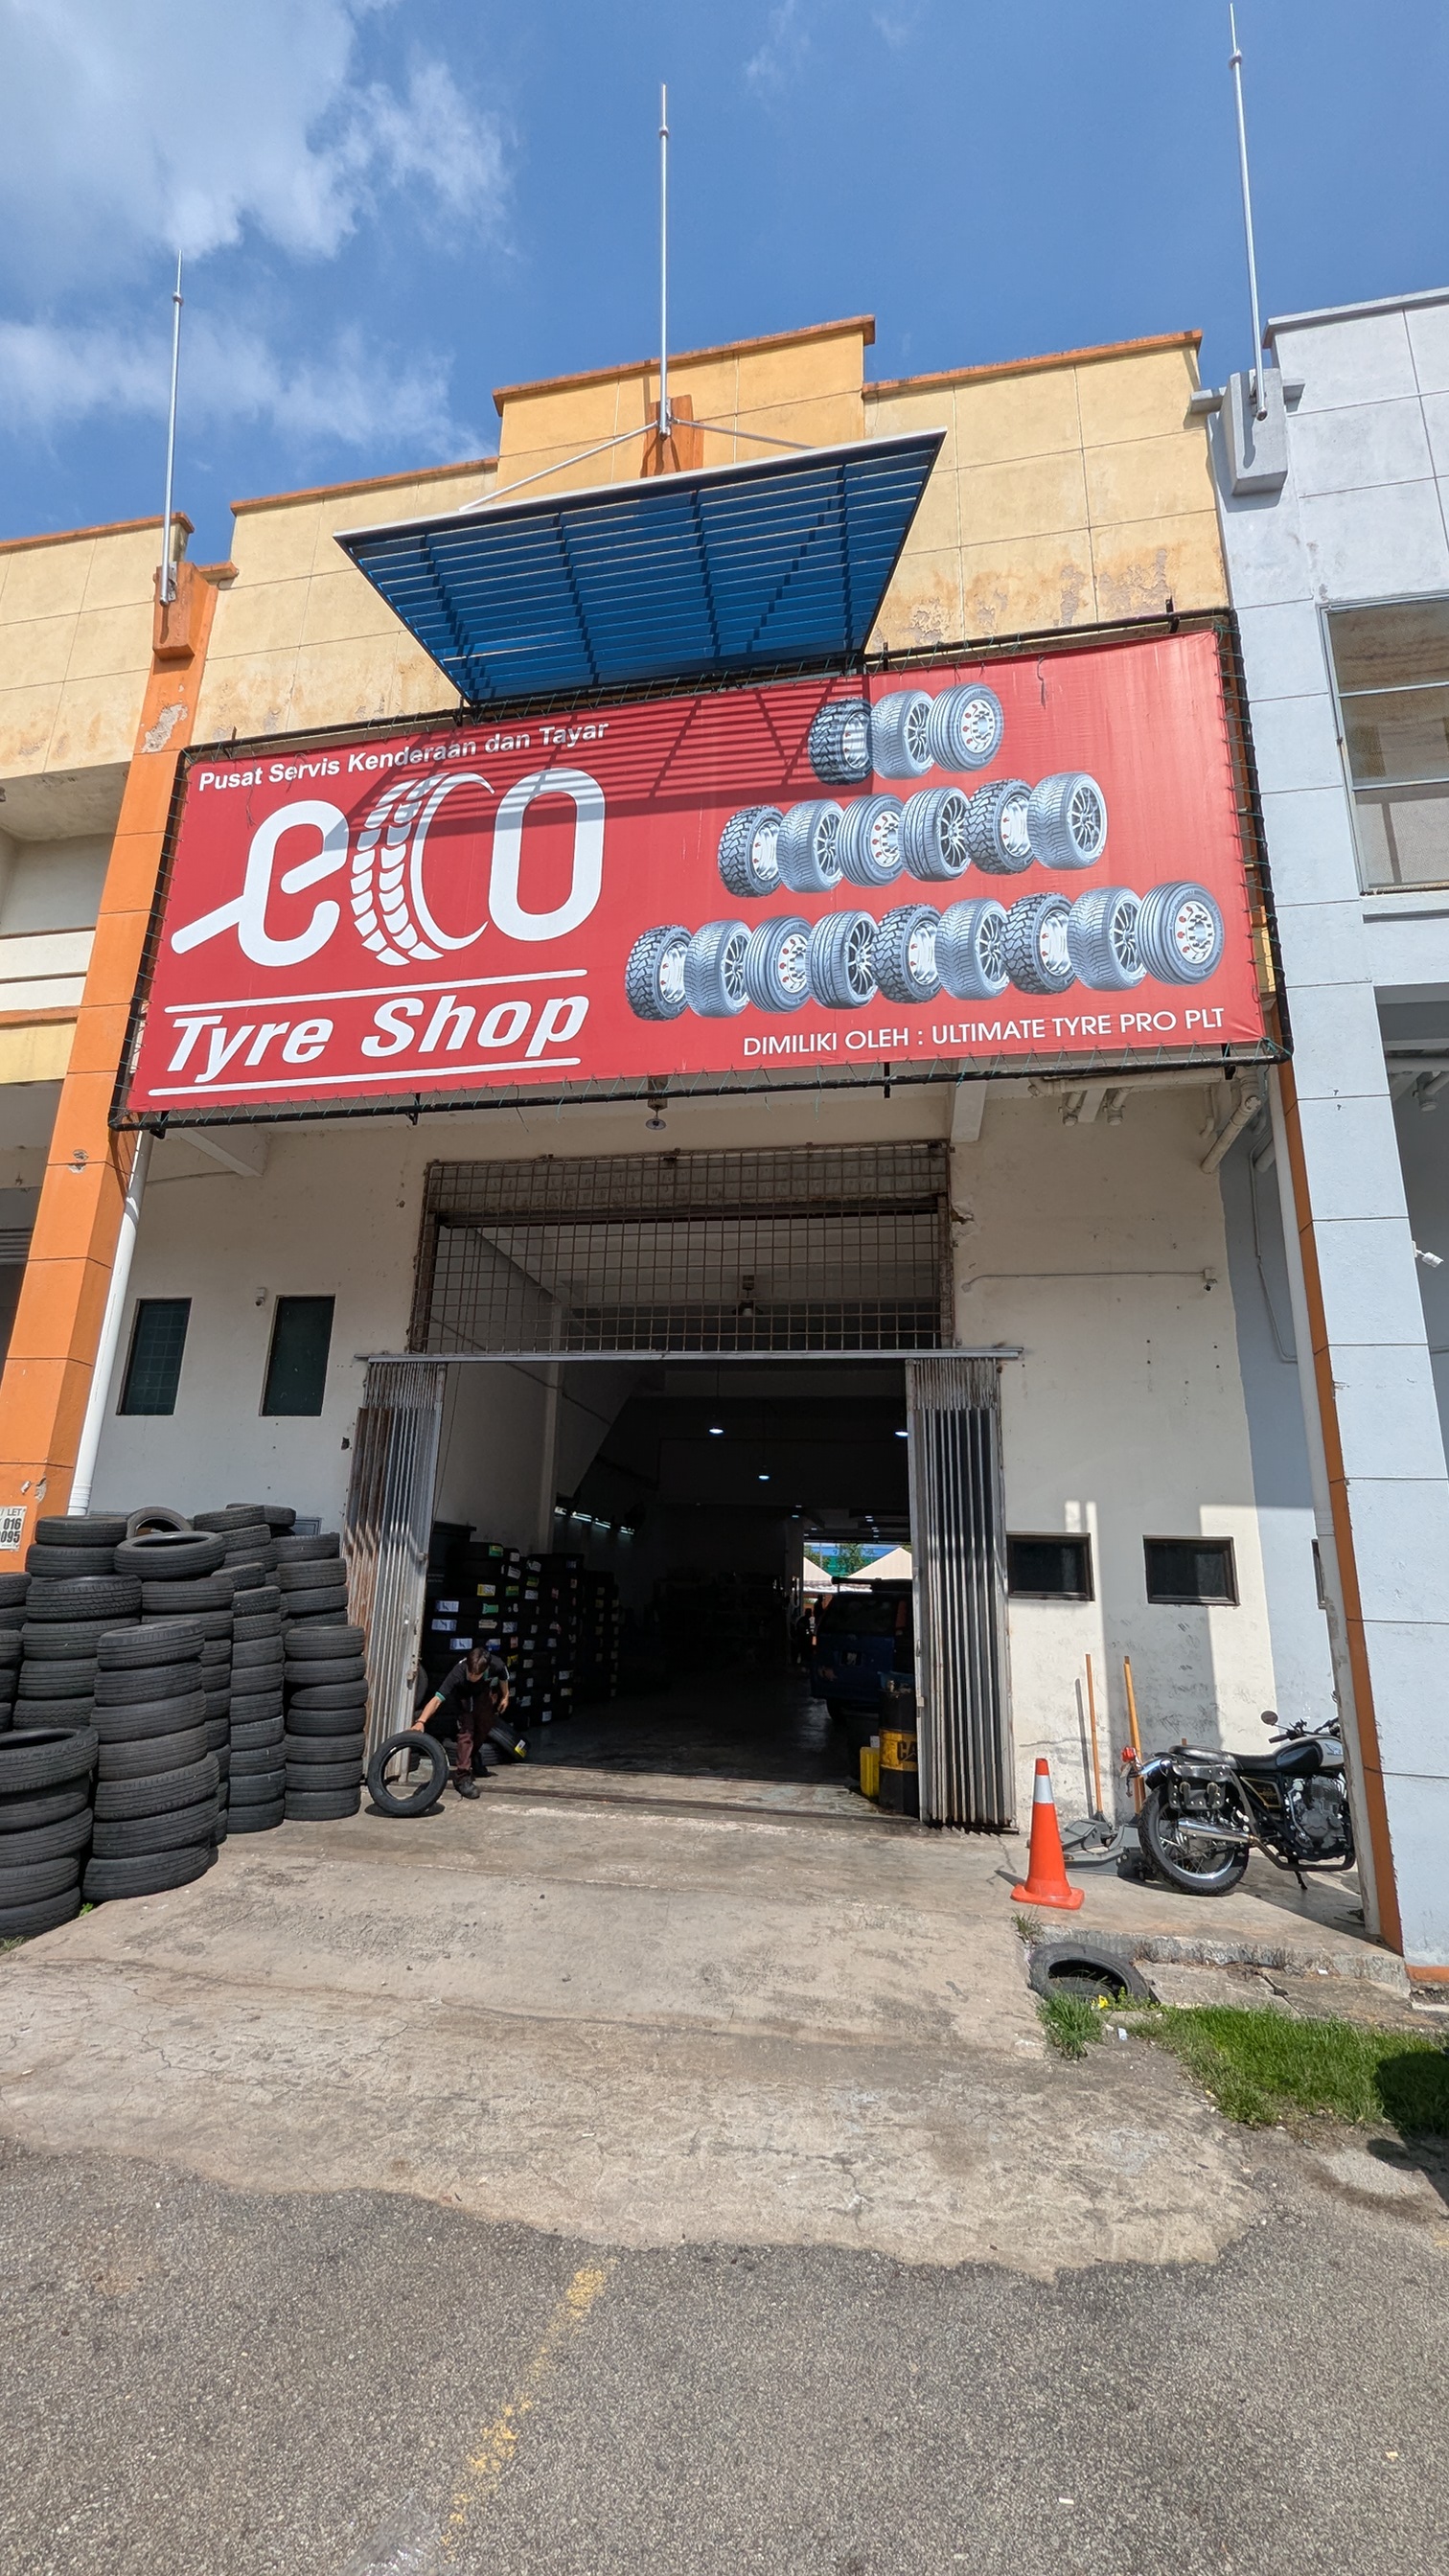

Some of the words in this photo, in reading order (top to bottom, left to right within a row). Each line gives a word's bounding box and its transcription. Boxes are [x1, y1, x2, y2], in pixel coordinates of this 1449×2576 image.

[198, 767, 264, 792] Pusat
[268, 758, 340, 783] Servis
[348, 740, 477, 772] Kenderaan
[485, 732, 531, 754] dan
[539, 723, 610, 748] Tayar
[166, 1015, 334, 1083] Tyre
[360, 996, 590, 1058] Shop
[743, 1032, 838, 1056] DIMILIKI
[844, 1027, 909, 1049] OLEH
[932, 1019, 1046, 1045] ULTIMATE
[1051, 1014, 1112, 1037] TYRE
[1119, 1011, 1177, 1033] PRO
[1184, 1007, 1225, 1030] PLT
[3, 1517, 22, 1530] 016
[7, 1507, 23, 1516] LET
[0, 1530, 21, 1543] 095
